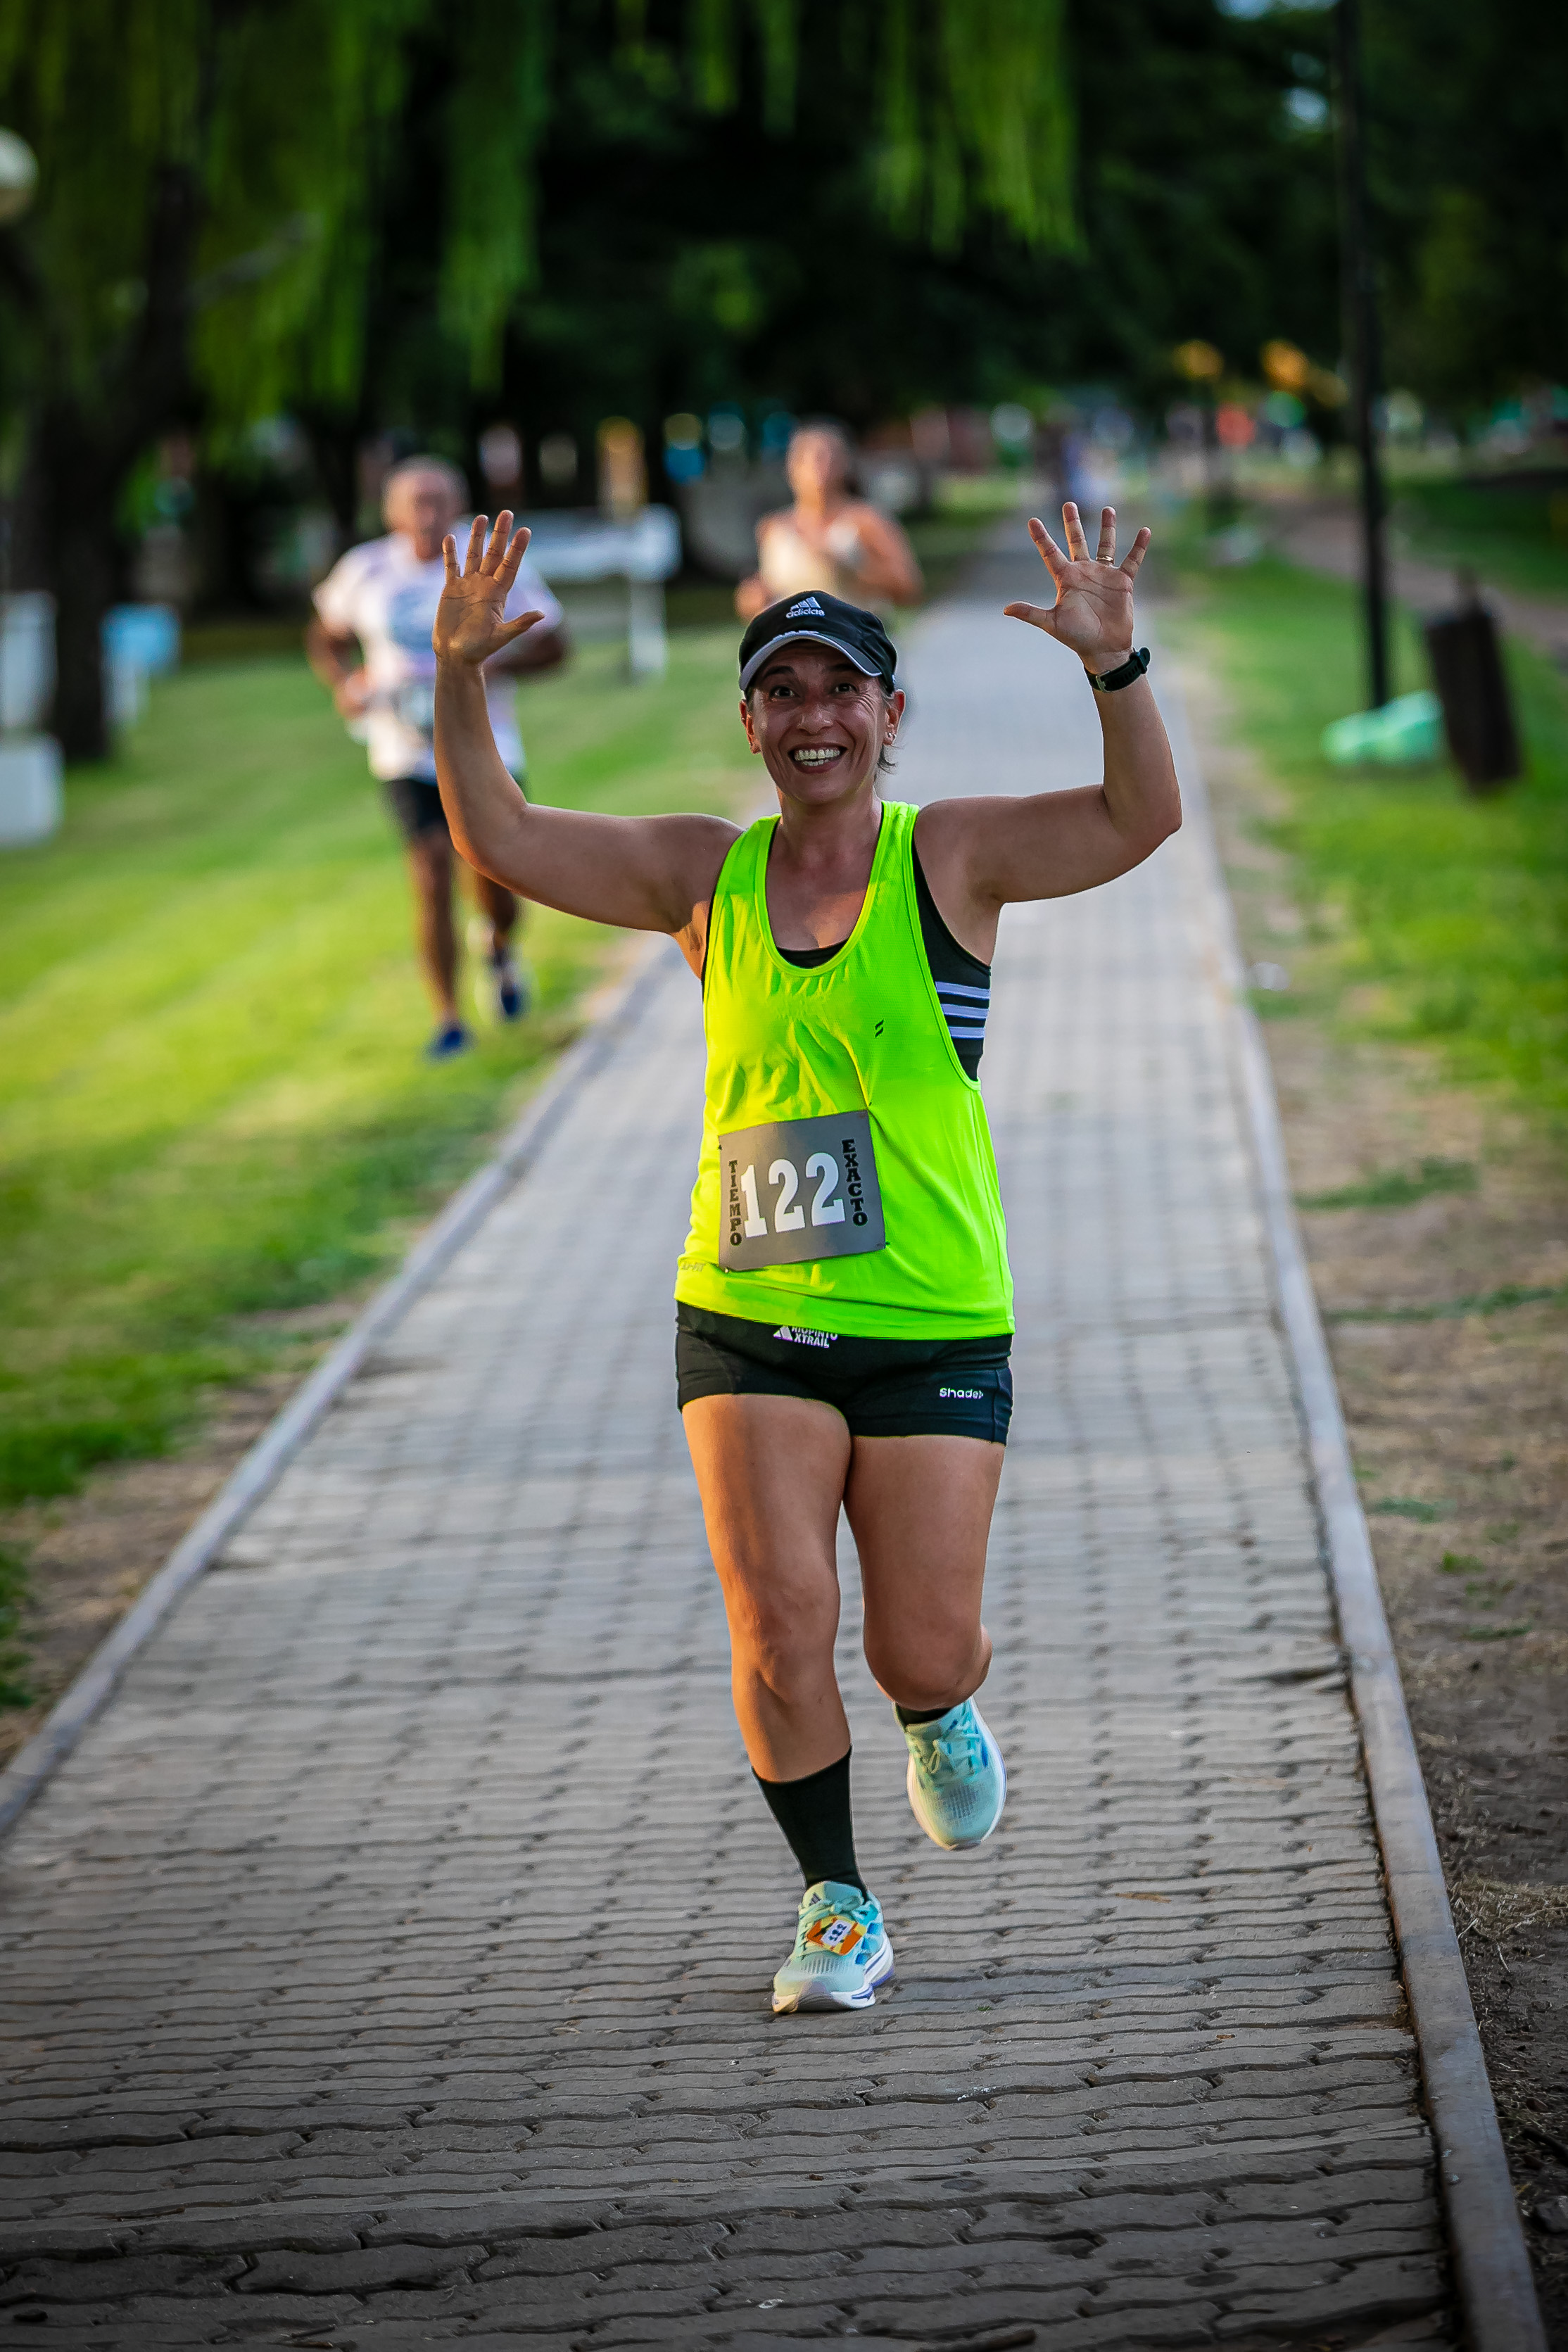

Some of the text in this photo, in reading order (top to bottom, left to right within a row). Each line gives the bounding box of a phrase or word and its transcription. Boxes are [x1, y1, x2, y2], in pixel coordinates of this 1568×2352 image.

[786, 607, 825, 619] adidas
[728, 1160, 742, 1246] TIEMPO
[740, 1152, 846, 1238] 122
[842, 1139, 868, 1227] EXACTO
[794, 1332, 830, 1348] XTRAIL
